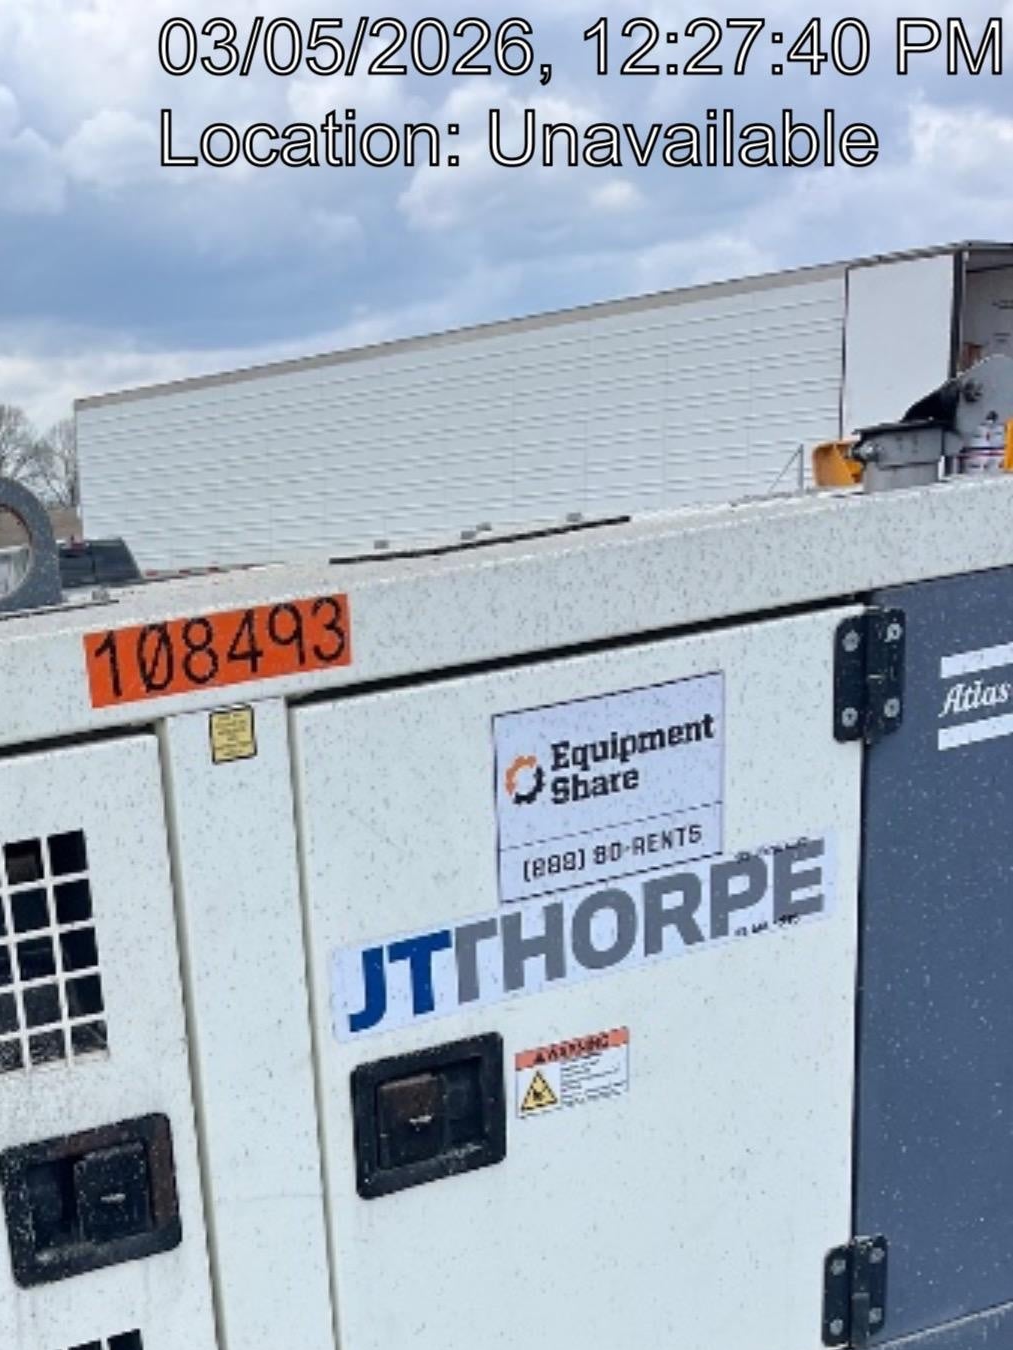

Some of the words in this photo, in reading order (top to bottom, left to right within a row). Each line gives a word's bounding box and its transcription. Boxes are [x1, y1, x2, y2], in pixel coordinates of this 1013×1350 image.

[94, 596, 348, 697] 108493
[937, 678, 1012, 718] Atlas
[550, 713, 715, 773] Equipment
[550, 767, 640, 805] Share
[522, 848, 586, 883] (888)
